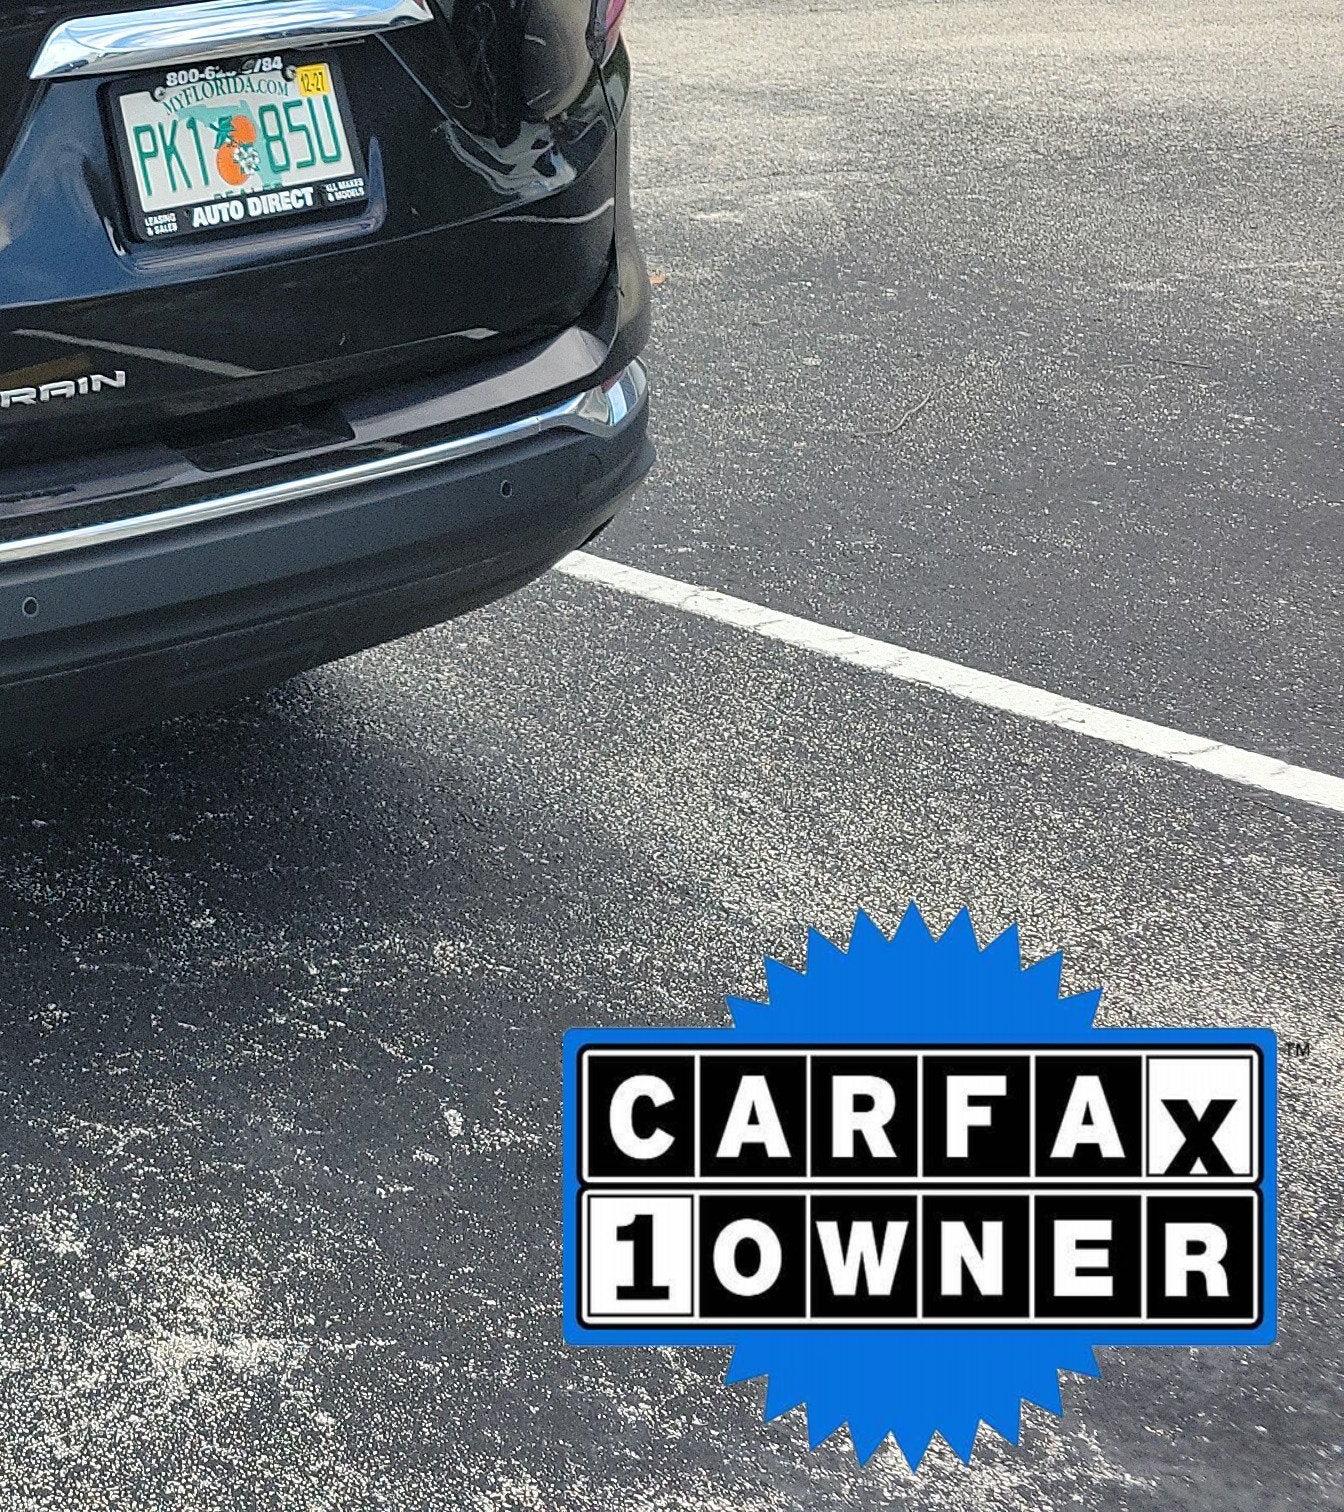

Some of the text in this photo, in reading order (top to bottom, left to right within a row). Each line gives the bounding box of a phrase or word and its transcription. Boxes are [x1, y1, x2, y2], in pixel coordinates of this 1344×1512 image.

[163, 76, 289, 115] MYFLORIDA.COM
[258, 95, 342, 174] 85U
[192, 199, 244, 228] AUTO
[247, 187, 314, 217] DIRECT
